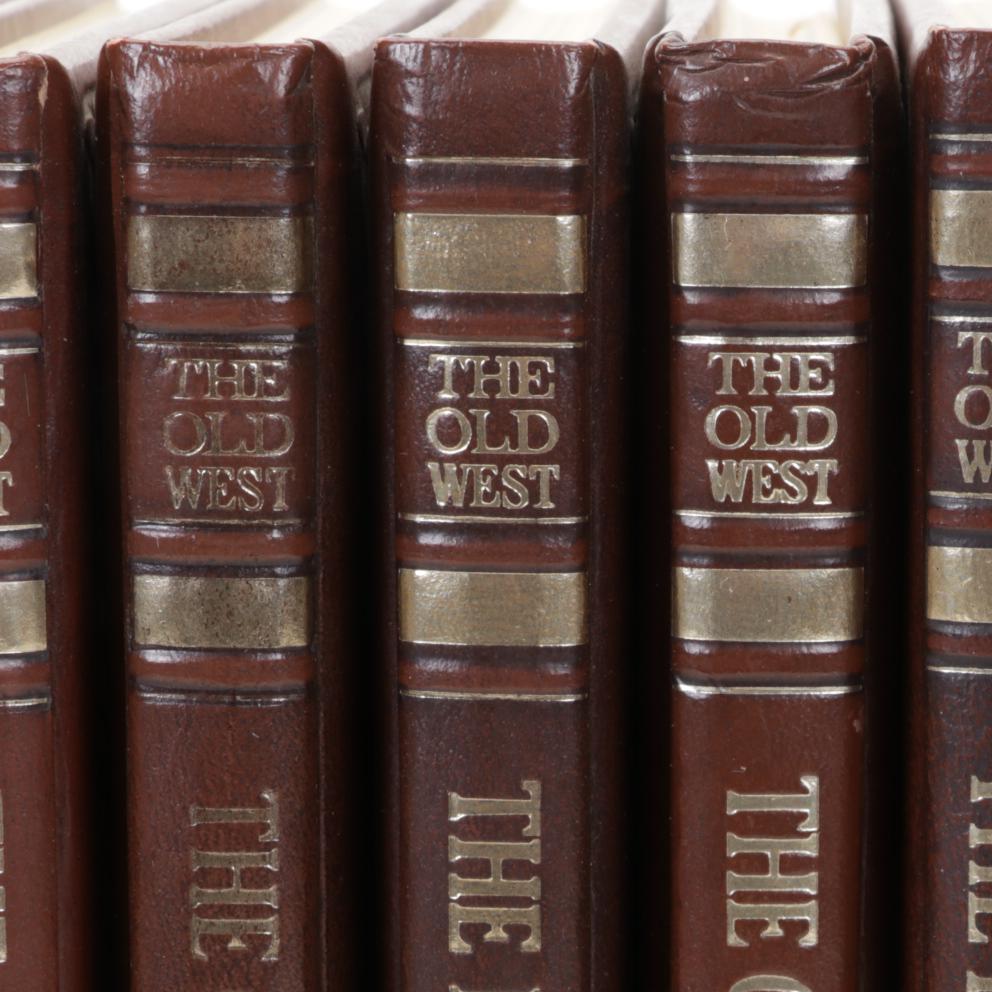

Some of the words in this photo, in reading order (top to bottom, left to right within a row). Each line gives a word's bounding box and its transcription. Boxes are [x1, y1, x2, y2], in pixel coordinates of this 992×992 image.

[164, 358, 290, 400] THE
[428, 354, 555, 400] THE
[708, 352, 835, 396] THE
[163, 410, 295, 456] OLD
[425, 407, 560, 455] OLD
[705, 405, 838, 451] OLD
[164, 464, 295, 511] WEST
[426, 463, 560, 509] WEST
[705, 458, 838, 504] WEST
[190, 790, 280, 962] THE
[447, 779, 542, 954] THE
[725, 775, 820, 949] THE
